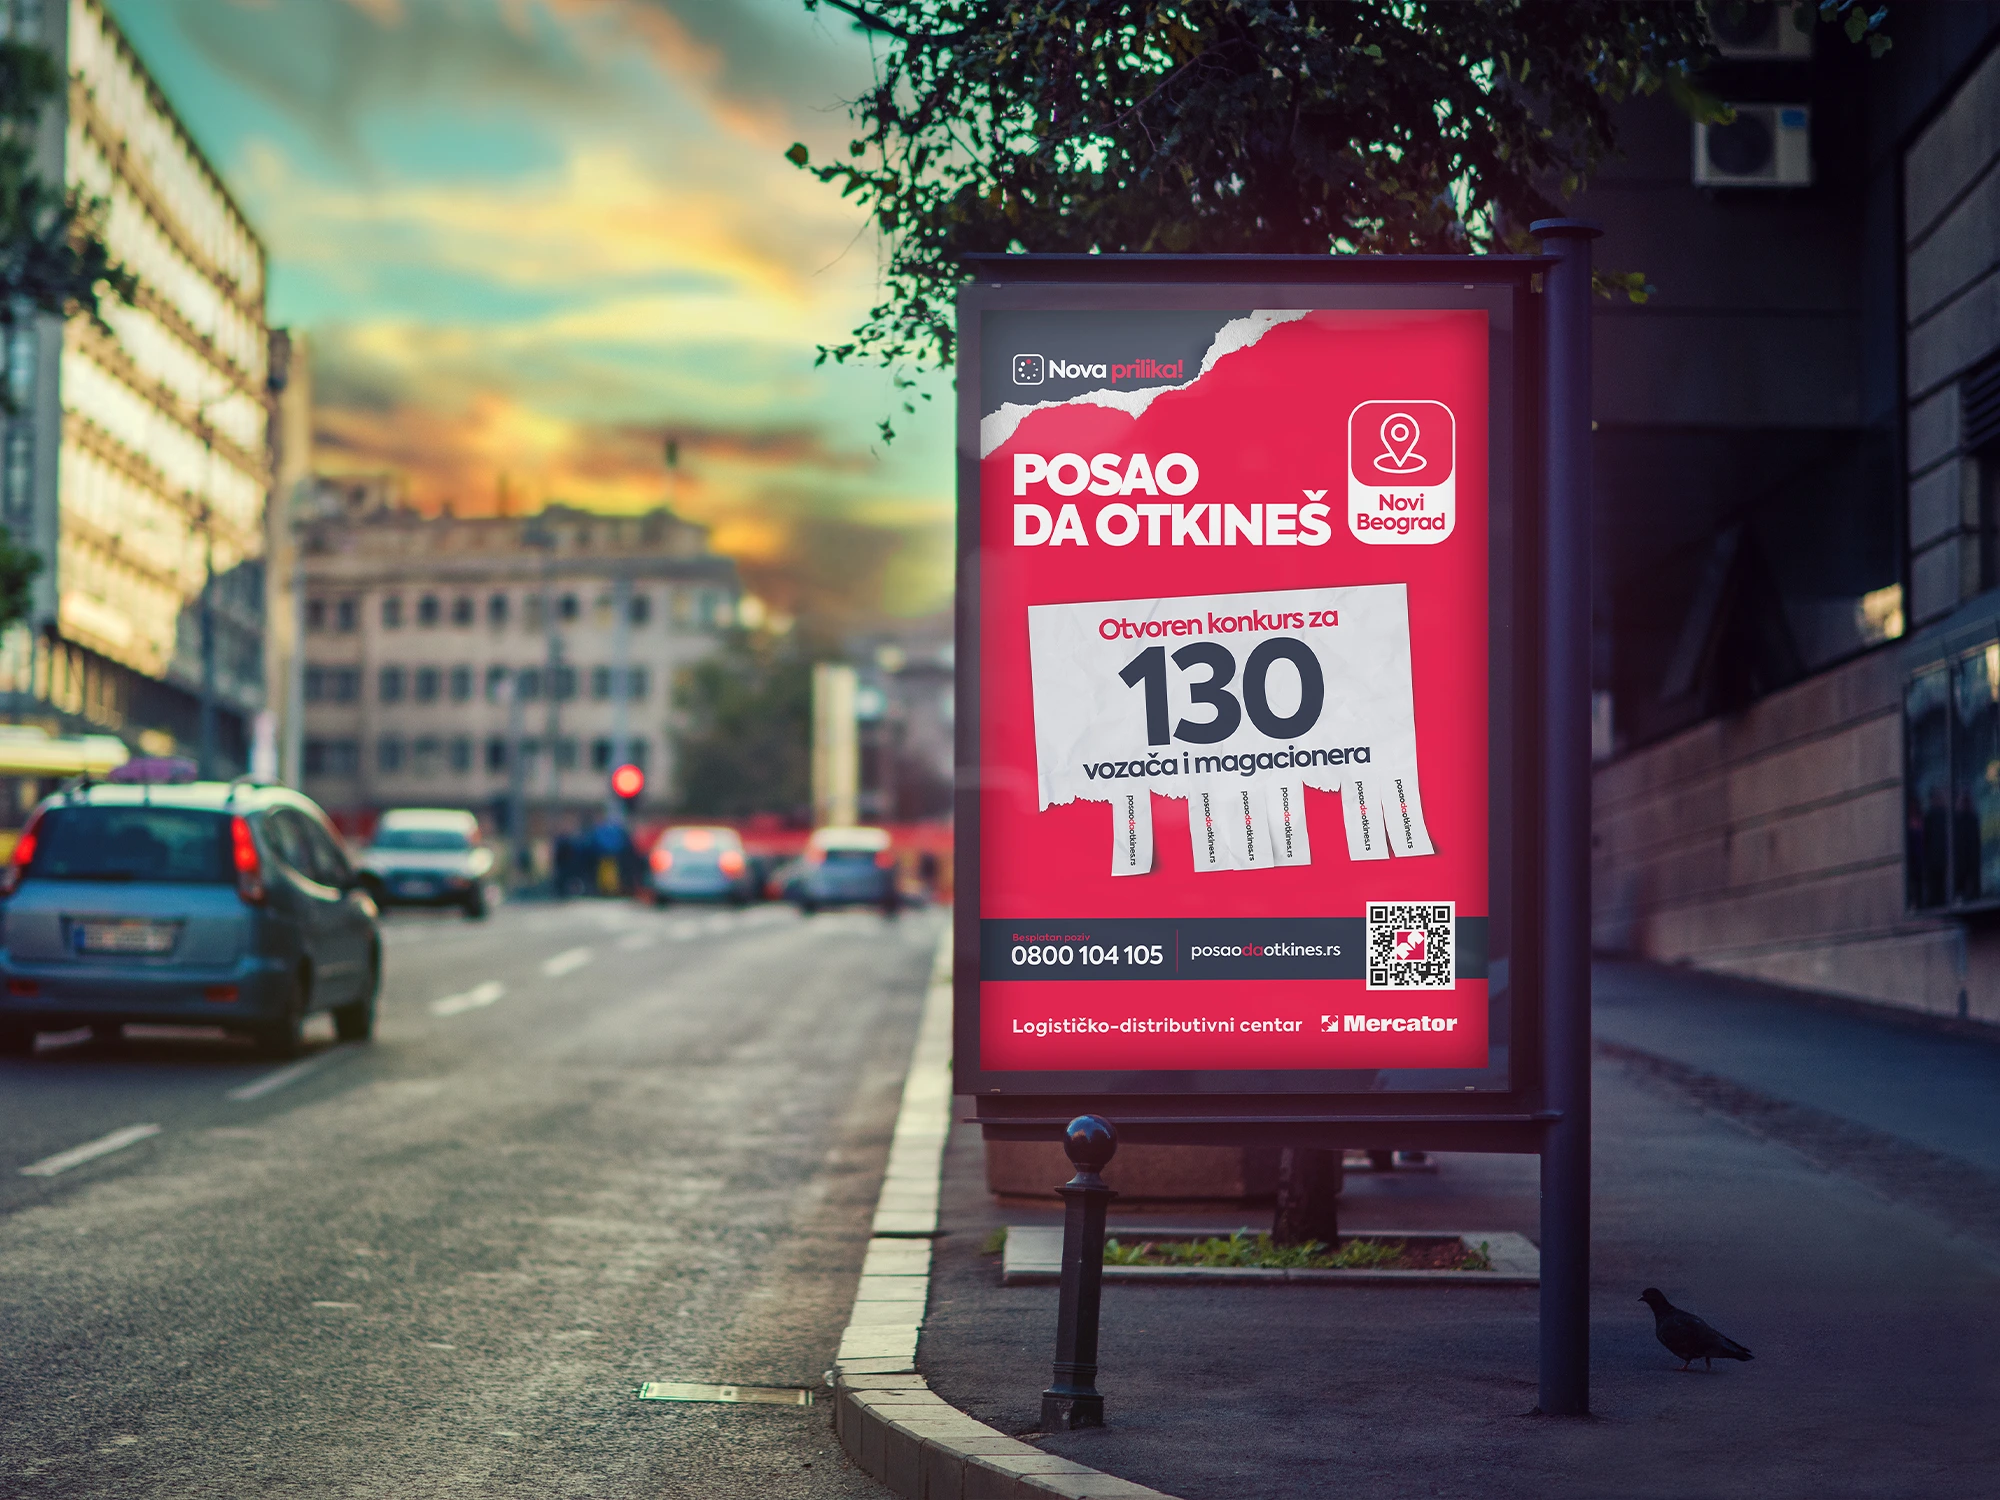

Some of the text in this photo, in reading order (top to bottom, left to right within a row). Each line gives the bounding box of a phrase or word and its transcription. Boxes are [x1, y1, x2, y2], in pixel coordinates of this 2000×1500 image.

[1049, 358, 1184, 383] Nova prilika!
[1013, 452, 1199, 497] POSAO
[1013, 489, 1332, 547] DA OTKINEŠ
[1379, 493, 1425, 511] Novi
[1357, 512, 1446, 535] Beograd
[1099, 609, 1339, 641] Otvoren konkurs za
[1118, 636, 1325, 746] 130
[1083, 745, 1371, 780] vozača i magacionera
[1126, 795, 1136, 866] posaodaotkines.rs
[1202, 792, 1216, 864] posaodaotkines.rs
[1241, 790, 1255, 862] posaodaotkines.rs
[1281, 787, 1293, 858] posaodaotkines.rs
[1355, 780, 1371, 851] posaodaotkines.rs
[1394, 779, 1414, 849] posaodaotkines.rs
[1011, 945, 1164, 966] 0800 104 105
[1012, 932, 1091, 944] Besplatan poziv
[1191, 941, 1341, 960] posaodaotkines.rs
[1012, 1016, 1303, 1037] Logističko-distributivni centar
[1344, 1015, 1458, 1032] Mercator
